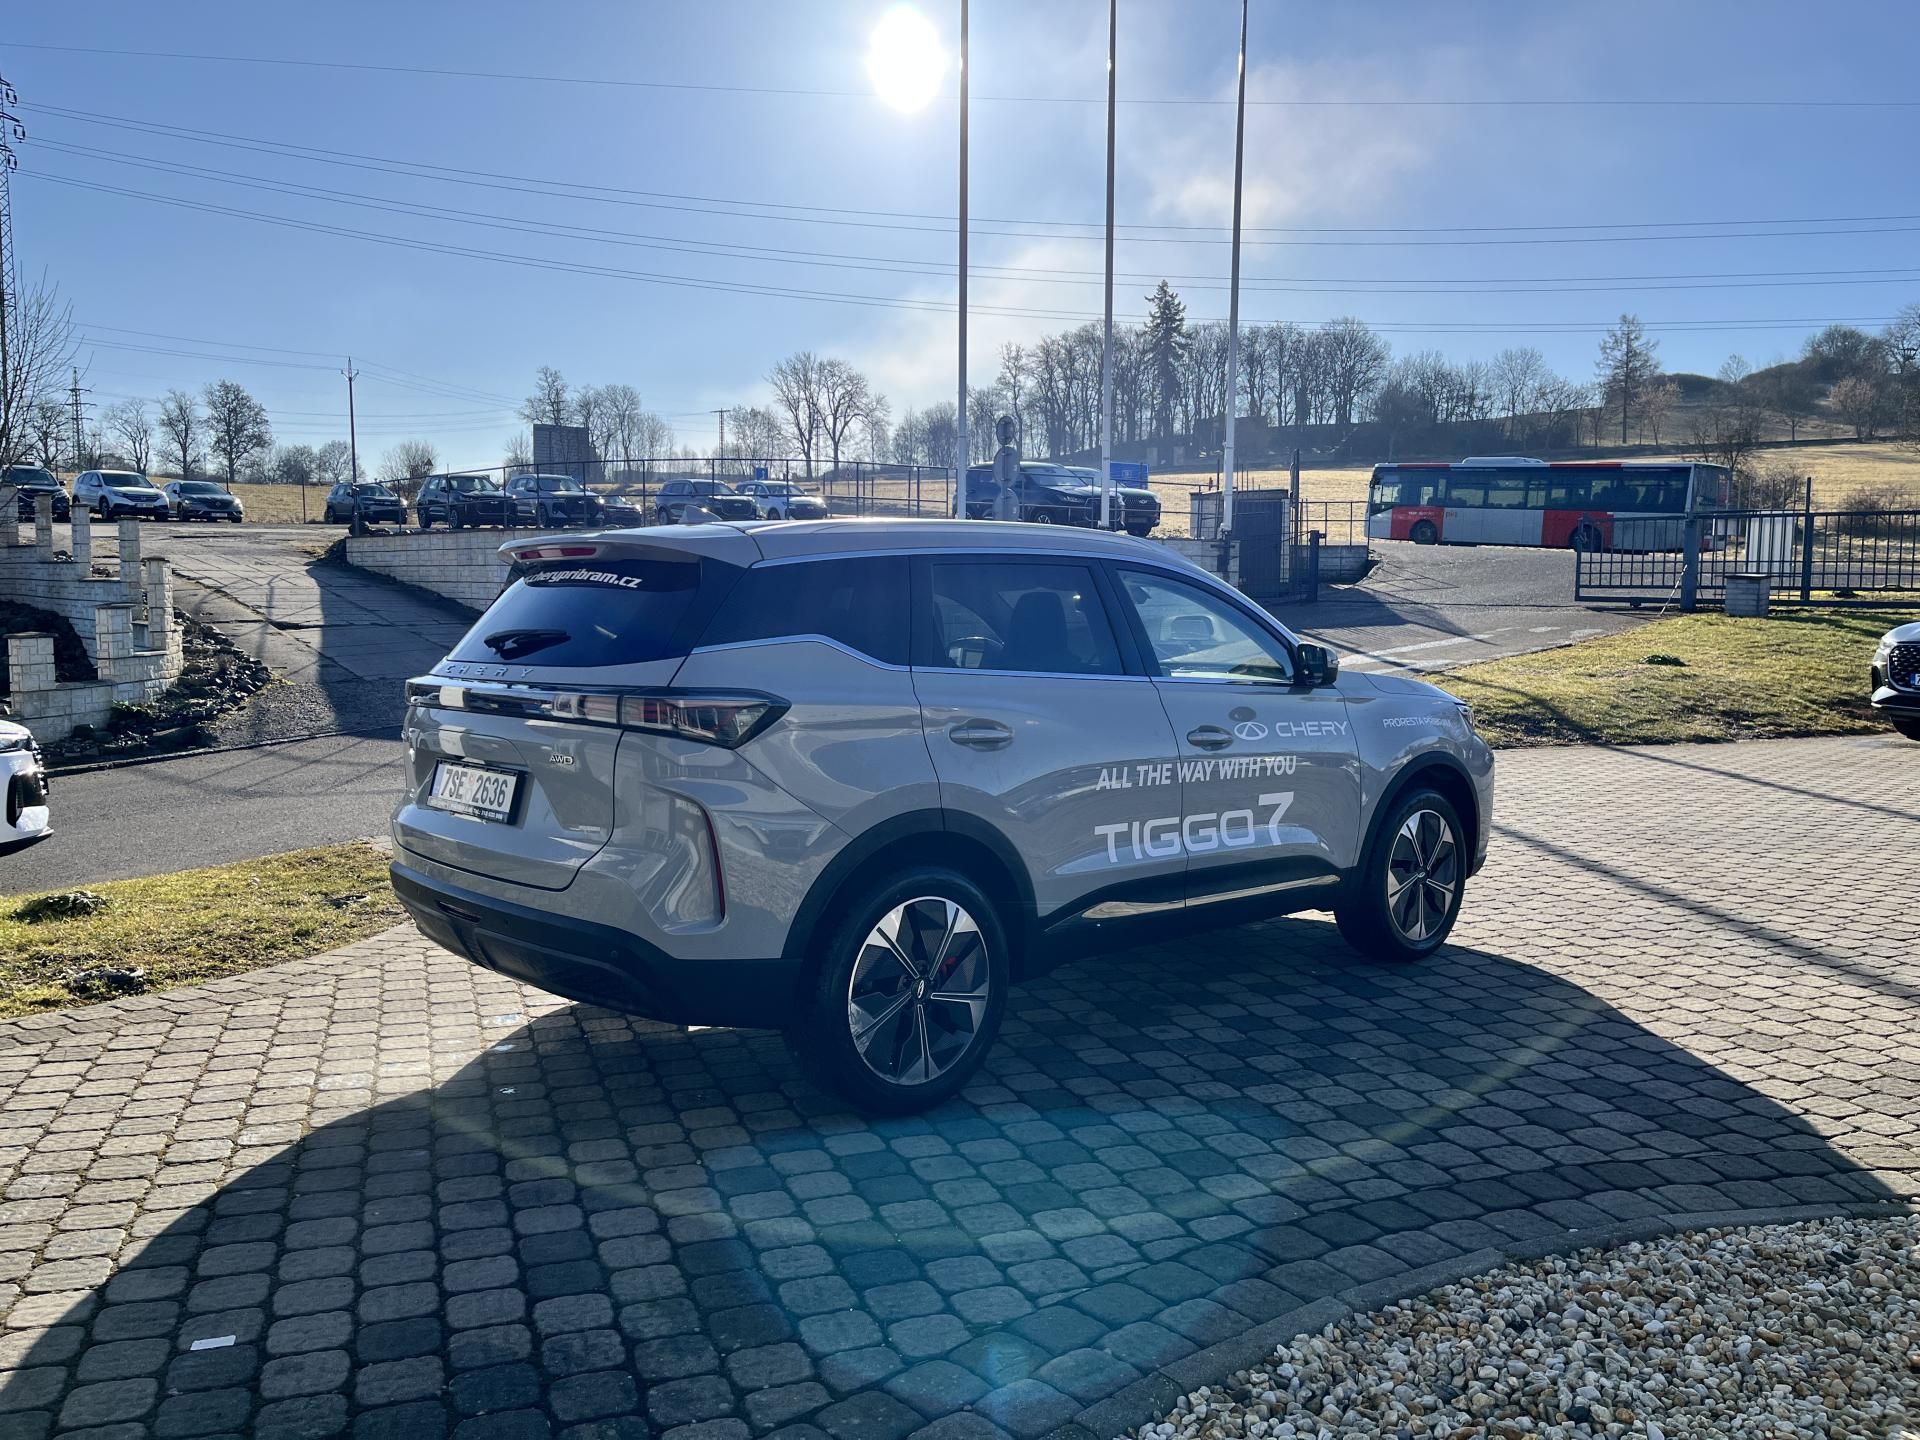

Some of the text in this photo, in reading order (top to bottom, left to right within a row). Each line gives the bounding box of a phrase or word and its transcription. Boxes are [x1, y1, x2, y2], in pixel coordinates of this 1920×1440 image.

[446, 665, 533, 679] CHERY
[1275, 721, 1348, 737] CHERY
[549, 754, 574, 765] AWD
[1095, 755, 1297, 791] ALL THE WAY WITH YOU
[440, 768, 508, 808] 7SE 2636
